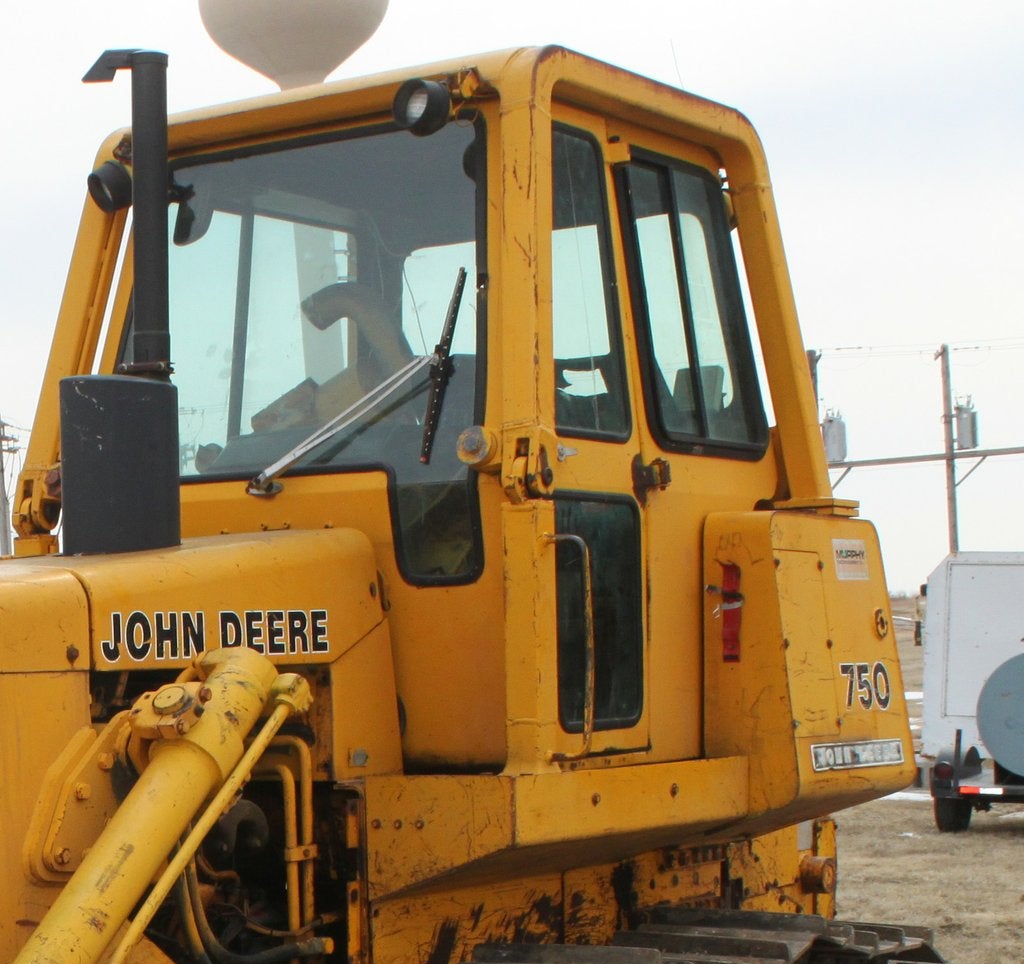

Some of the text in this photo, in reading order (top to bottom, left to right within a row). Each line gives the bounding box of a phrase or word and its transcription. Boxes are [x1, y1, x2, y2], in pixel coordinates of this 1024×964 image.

[101, 609, 329, 664] JOHN DEERE
[839, 661, 891, 711] 750
